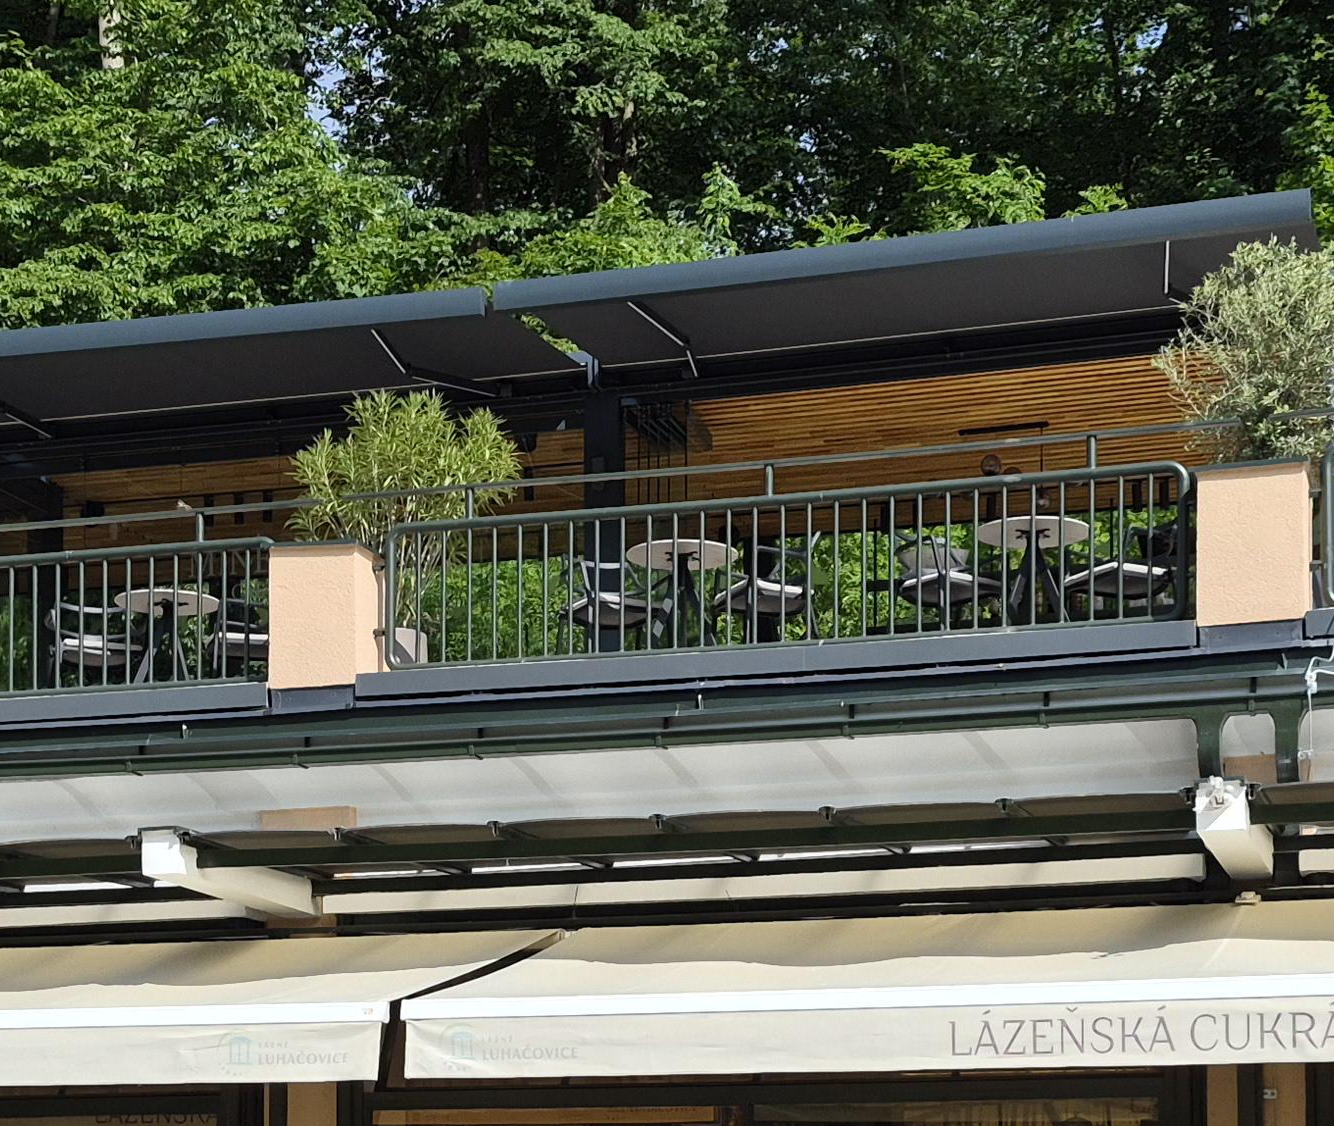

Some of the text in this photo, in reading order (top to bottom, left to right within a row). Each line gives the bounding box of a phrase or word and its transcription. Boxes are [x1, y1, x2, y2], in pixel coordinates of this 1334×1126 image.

[948, 1004, 1176, 1057] LÁZEŇSKÁ
[258, 1049, 348, 1065] LUHAČOVICE
[482, 1043, 579, 1061] LUHAČOVICE
